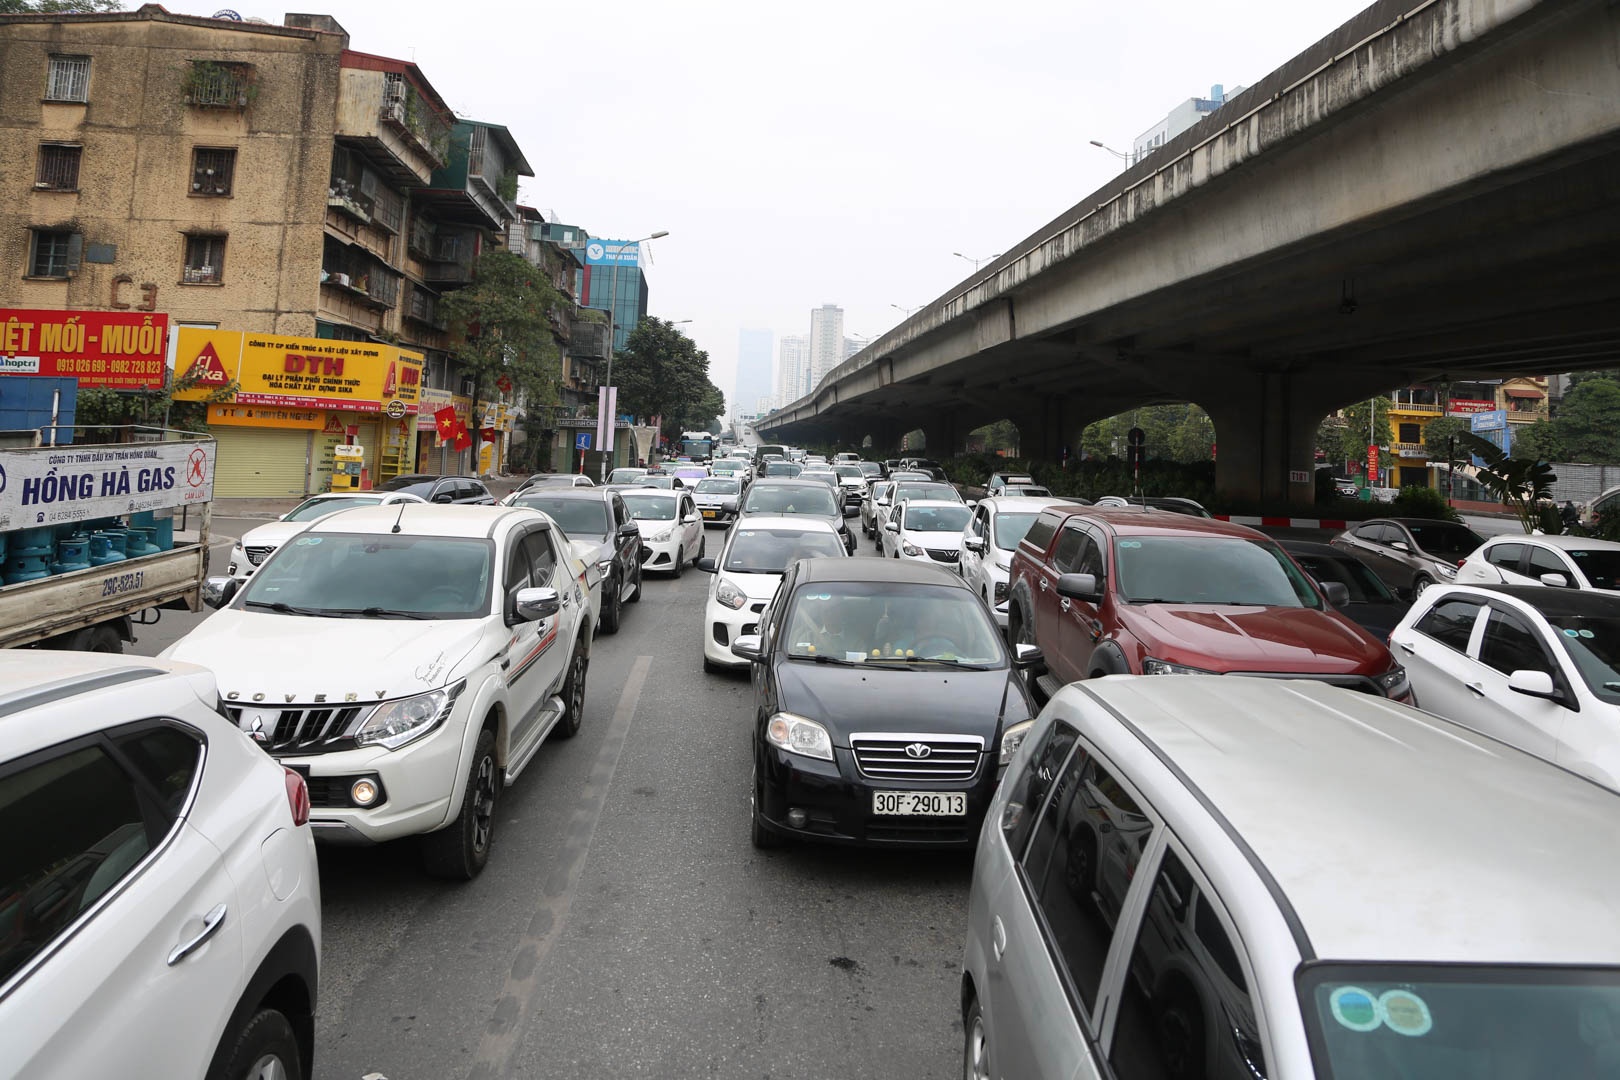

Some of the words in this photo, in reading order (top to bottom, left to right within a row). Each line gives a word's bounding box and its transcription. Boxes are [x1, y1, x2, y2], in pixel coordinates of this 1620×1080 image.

[40, 316, 86, 354] MỐI
[101, 316, 162, 354] MUỖI
[286, 342, 300, 350] KIẾN
[5, 359, 36, 368] hoptri
[56, 358, 74, 372] 0913
[76, 359, 90, 372] 026
[131, 360, 145, 374] 728
[146, 360, 160, 374] 823
[284, 354, 344, 376] DTH
[284, 381, 302, 390] CHẤT
[303, 382, 316, 390] XÂY
[285, 374, 304, 382] PHÂN
[323, 376, 342, 385] CHÍNH
[344, 378, 360, 386] THỨC
[256, 410, 288, 419] CHUYÊN
[290, 412, 318, 420] NGHIỆP
[49, 455, 66, 464] CÔNG
[67, 456, 74, 464] TY
[76, 454, 91, 462] TNHH
[22, 467, 94, 505] HỒNG
[101, 466, 130, 496] HÀ
[138, 466, 176, 492] GAS
[102, 571, 144, 597] 29C-523.51
[876, 794, 964, 813] 30F-290.13
